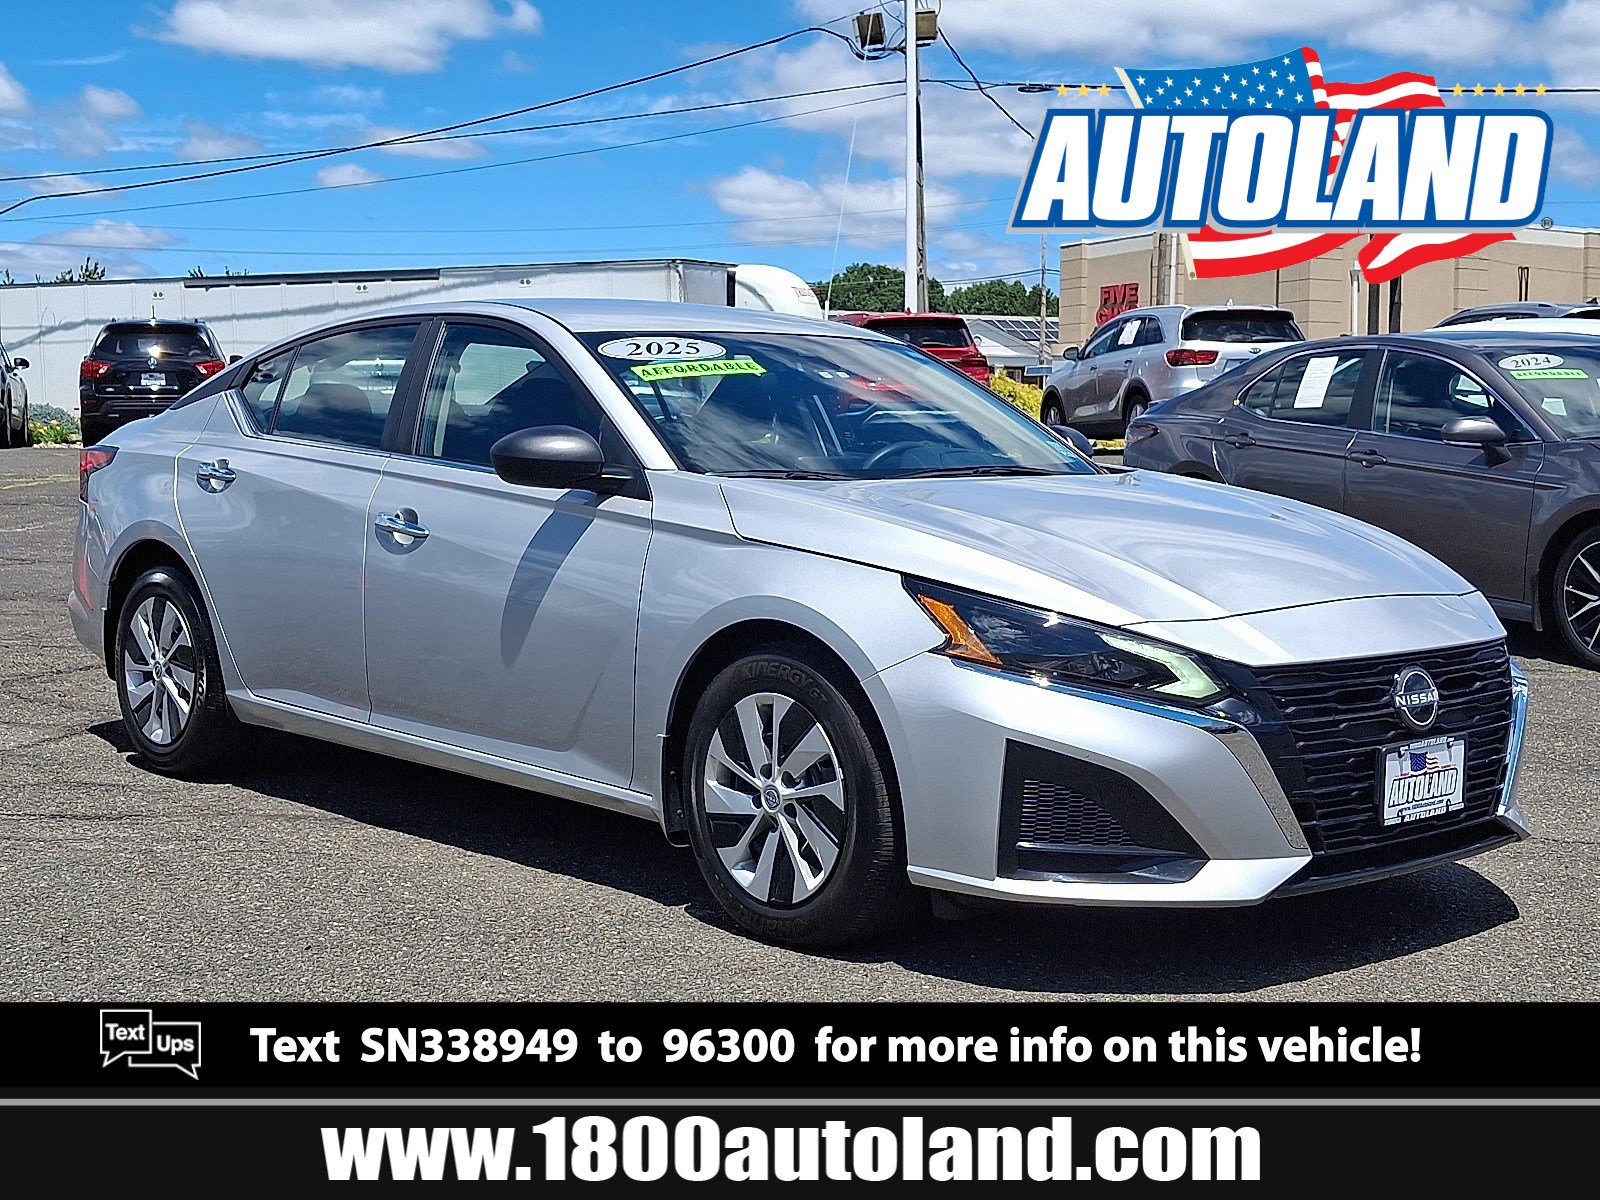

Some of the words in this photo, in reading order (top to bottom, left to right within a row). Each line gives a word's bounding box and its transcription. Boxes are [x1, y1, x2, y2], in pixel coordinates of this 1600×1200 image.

[1100, 283, 1139, 305] FIVE
[625, 341, 701, 357] 2025
[640, 361, 759, 379] AFFORDABLE
[1511, 357, 1552, 368] 2024
[1395, 690, 1439, 708] NISSAN
[1388, 768, 1458, 807] AUTOLAND
